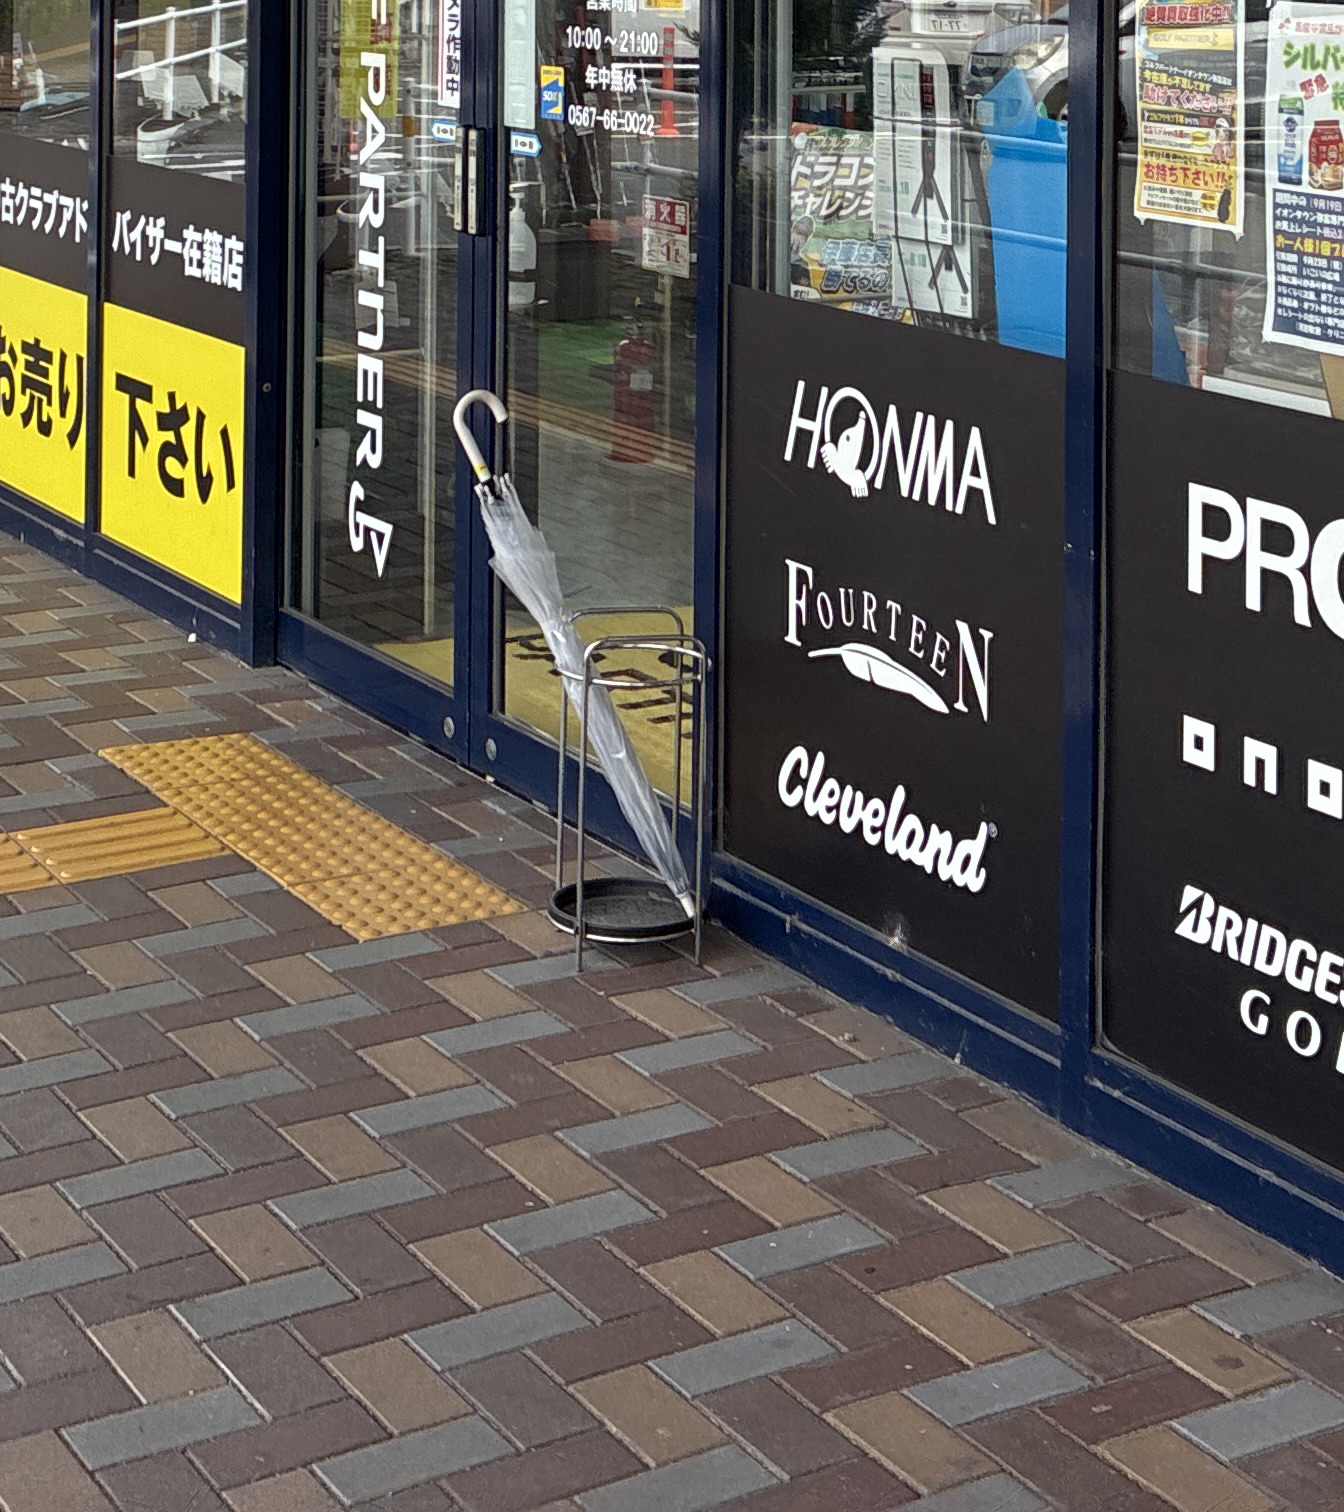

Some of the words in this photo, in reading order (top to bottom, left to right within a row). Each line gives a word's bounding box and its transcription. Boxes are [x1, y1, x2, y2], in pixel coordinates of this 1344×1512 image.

[567, 104, 655, 138] 0567-66-0022
[584, 63, 638, 94] 年中無休
[112, 209, 244, 292] バイザー在籍店
[355, 52, 387, 469] PARTNER
[114, 372, 236, 505] 下さい
[784, 379, 998, 526] HONMA
[784, 558, 995, 723] FOURTEEN
[777, 745, 988, 894] Cleveland
